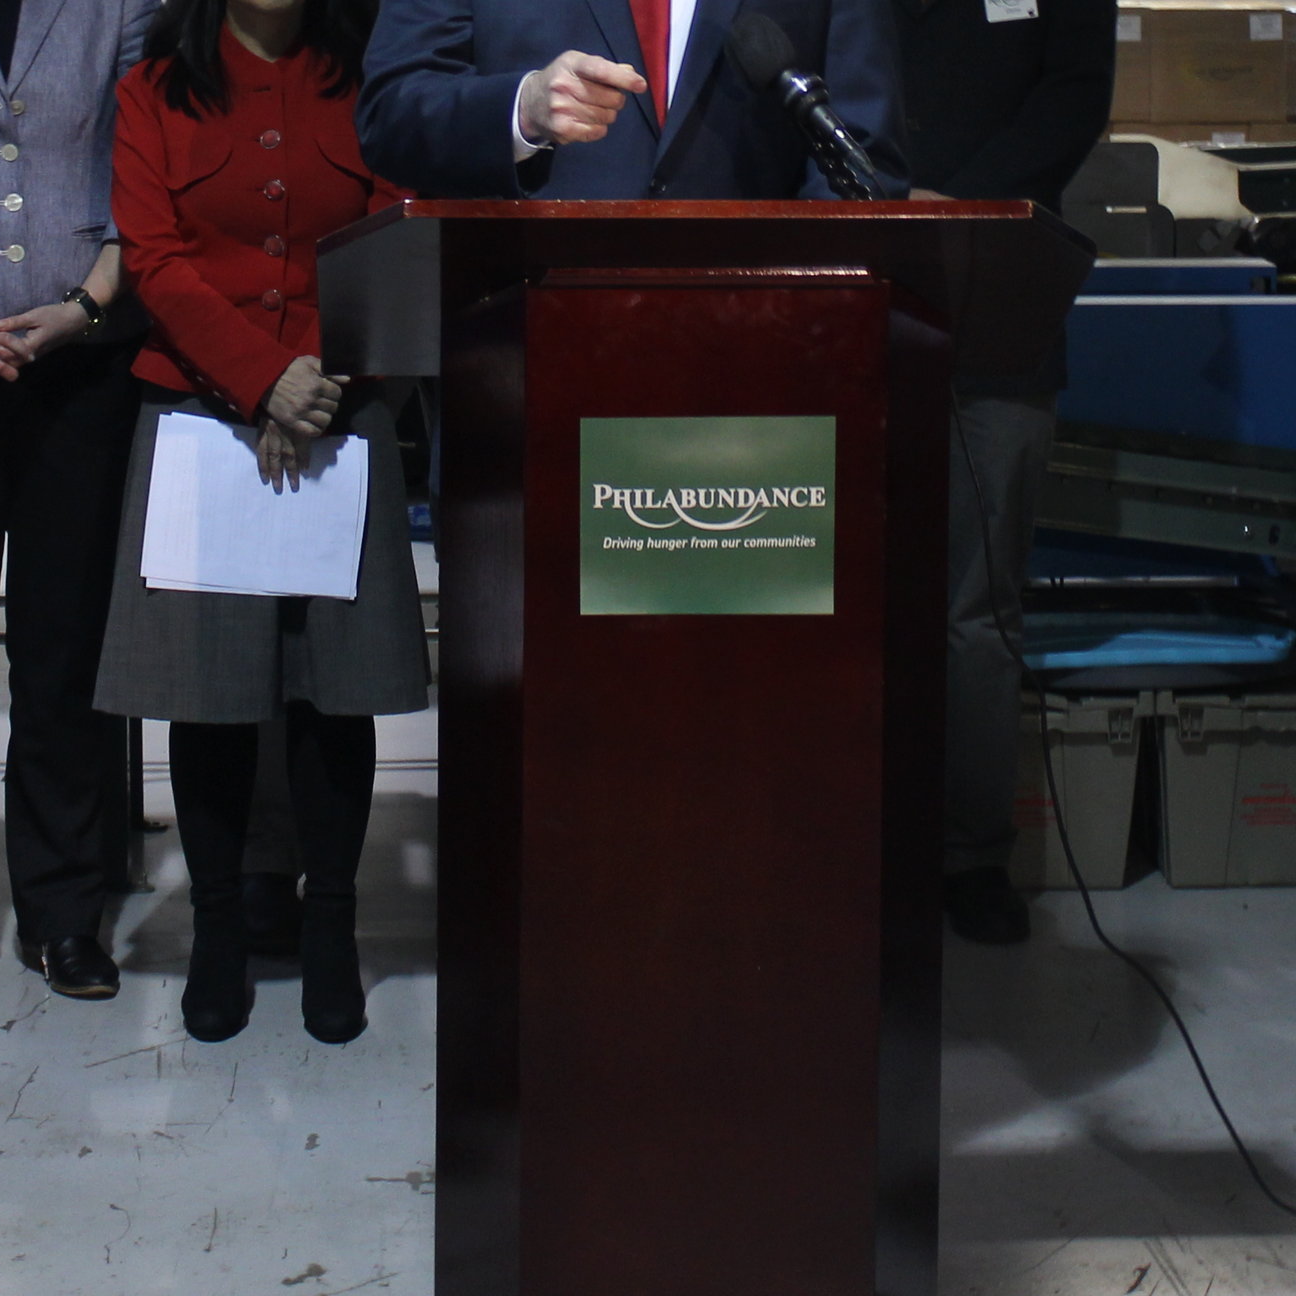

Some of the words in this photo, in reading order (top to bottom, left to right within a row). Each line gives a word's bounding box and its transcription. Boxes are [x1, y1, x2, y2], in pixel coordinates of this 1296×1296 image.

[593, 483, 826, 530] PHILABUNDANCE
[603, 536, 644, 552] Driving
[647, 536, 688, 552] hunger
[690, 535, 718, 549] from
[721, 538, 741, 548] our
[744, 534, 817, 548] communities
